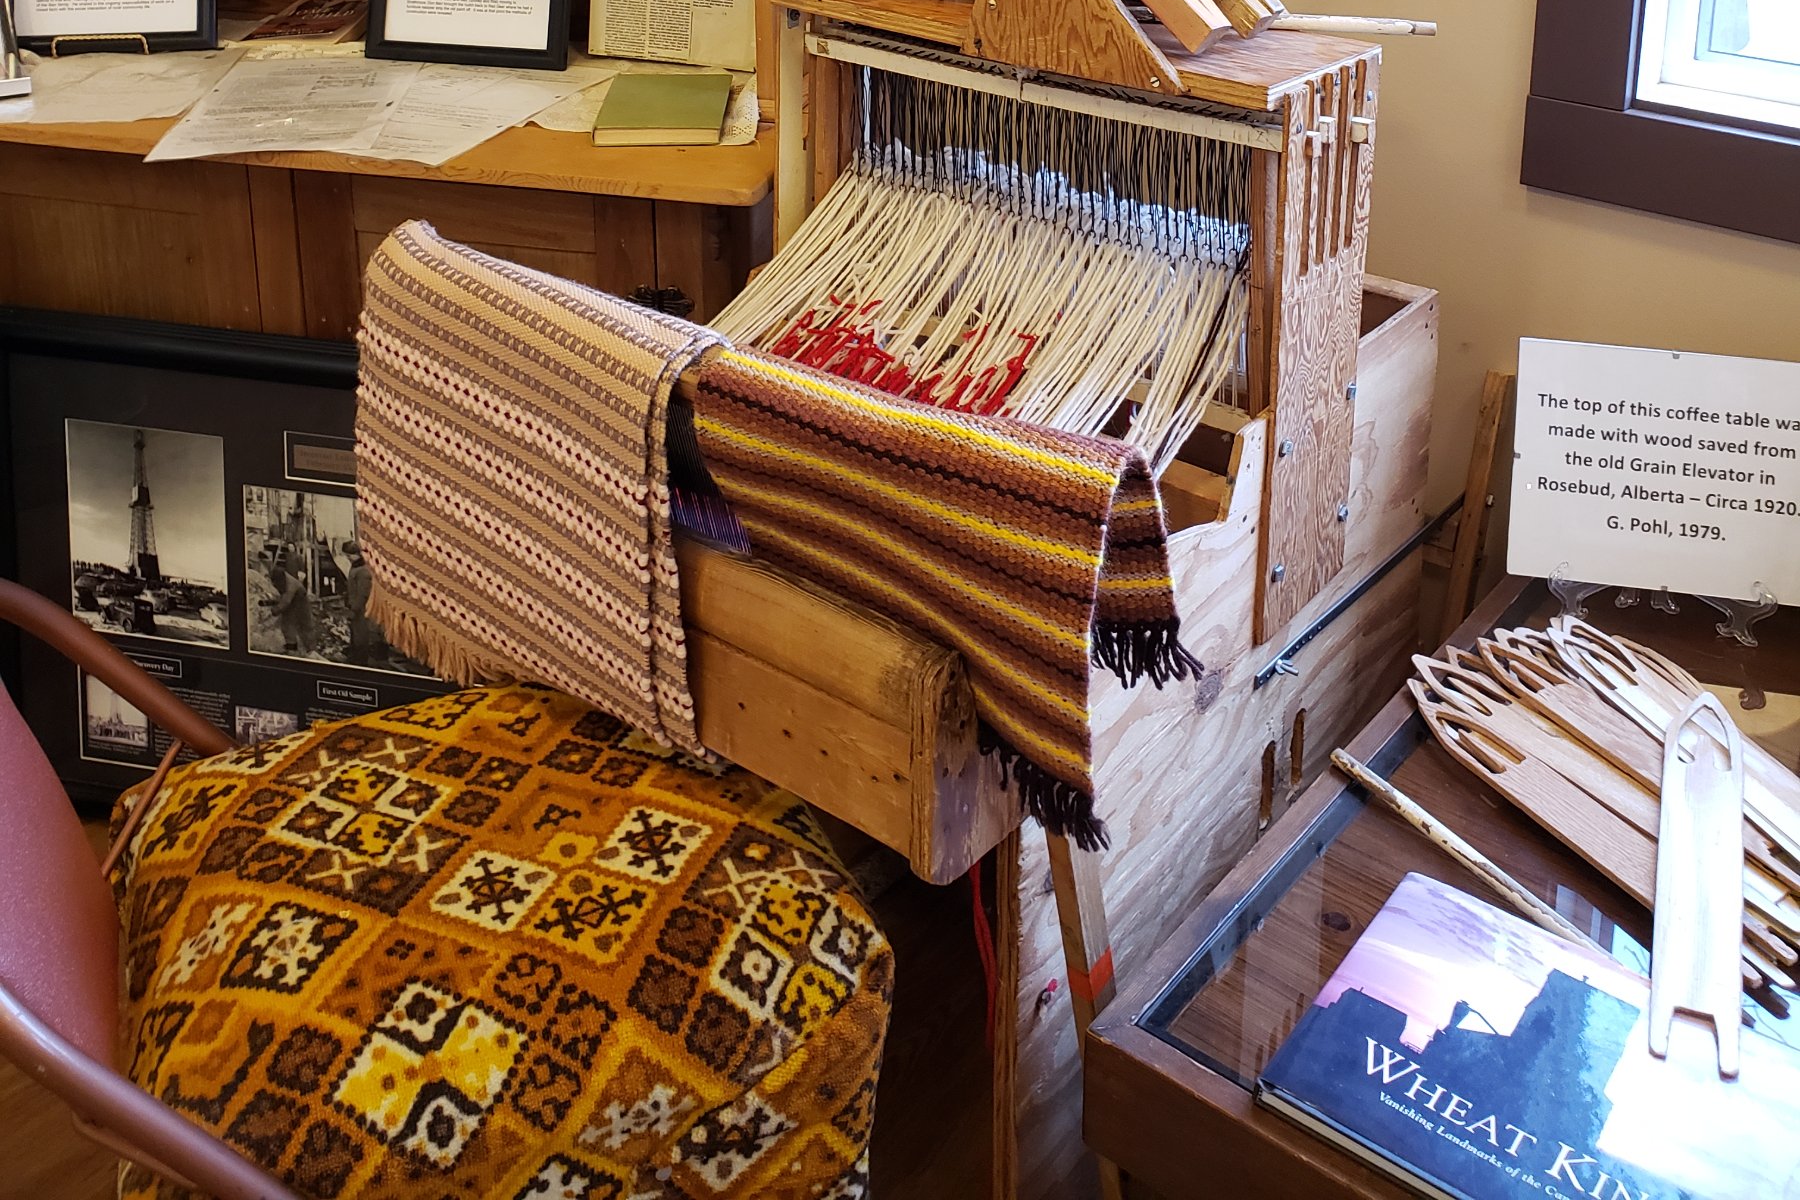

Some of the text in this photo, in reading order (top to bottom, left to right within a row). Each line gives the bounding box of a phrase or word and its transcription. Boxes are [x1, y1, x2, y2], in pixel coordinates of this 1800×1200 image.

[1538, 393, 1568, 410] The
[1574, 398, 1601, 415] top
[1607, 401, 1625, 414] of
[1630, 402, 1661, 418] this
[1666, 407, 1720, 423] coffee
[1726, 412, 1770, 428] table
[1549, 424, 1796, 459] made with wood saved from
[1565, 452, 1775, 486] the old Grain Elevator in
[1537, 477, 1615, 499] Rosebud,
[1621, 485, 1684, 504] Alberta
[1706, 494, 1747, 511] Circa
[1753, 499, 1800, 516] 1920.
[1607, 516, 1726, 541] G. Pohl, 1979.
[162, 663, 174, 672] Day
[322, 687, 337, 695] First
[349, 691, 372, 701] Sample
[1365, 1037, 1538, 1157] WHEAT
[1380, 1091, 1434, 1131] Vanishing
[1437, 1126, 1502, 1168] Landmarks
[1505, 1166, 1521, 1178] of
[1522, 1173, 1542, 1189] the
